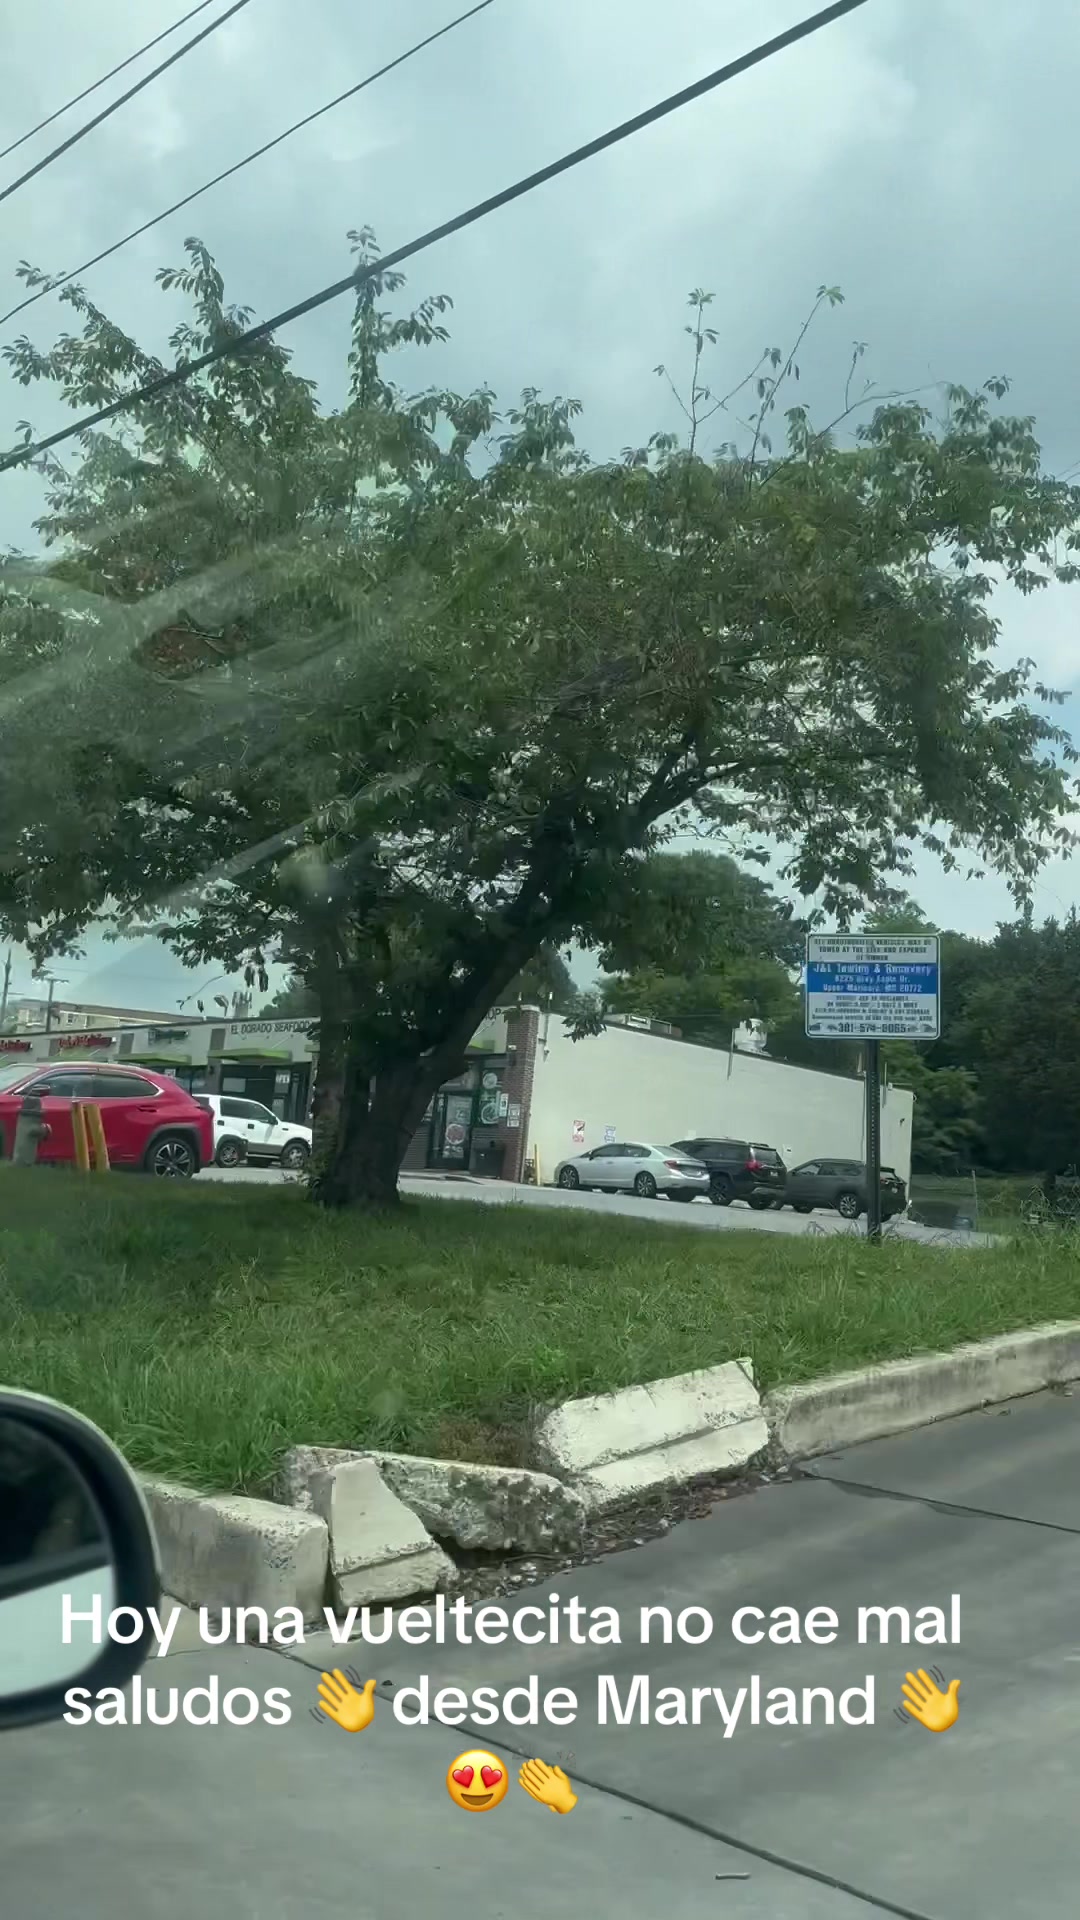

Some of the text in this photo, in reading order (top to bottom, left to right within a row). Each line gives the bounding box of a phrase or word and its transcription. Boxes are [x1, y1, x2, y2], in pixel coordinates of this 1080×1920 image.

[836, 963, 870, 975] Towing
[873, 963, 881, 973] &
[231, 1025, 238, 1035] EL
[241, 1023, 272, 1034] DORADO
